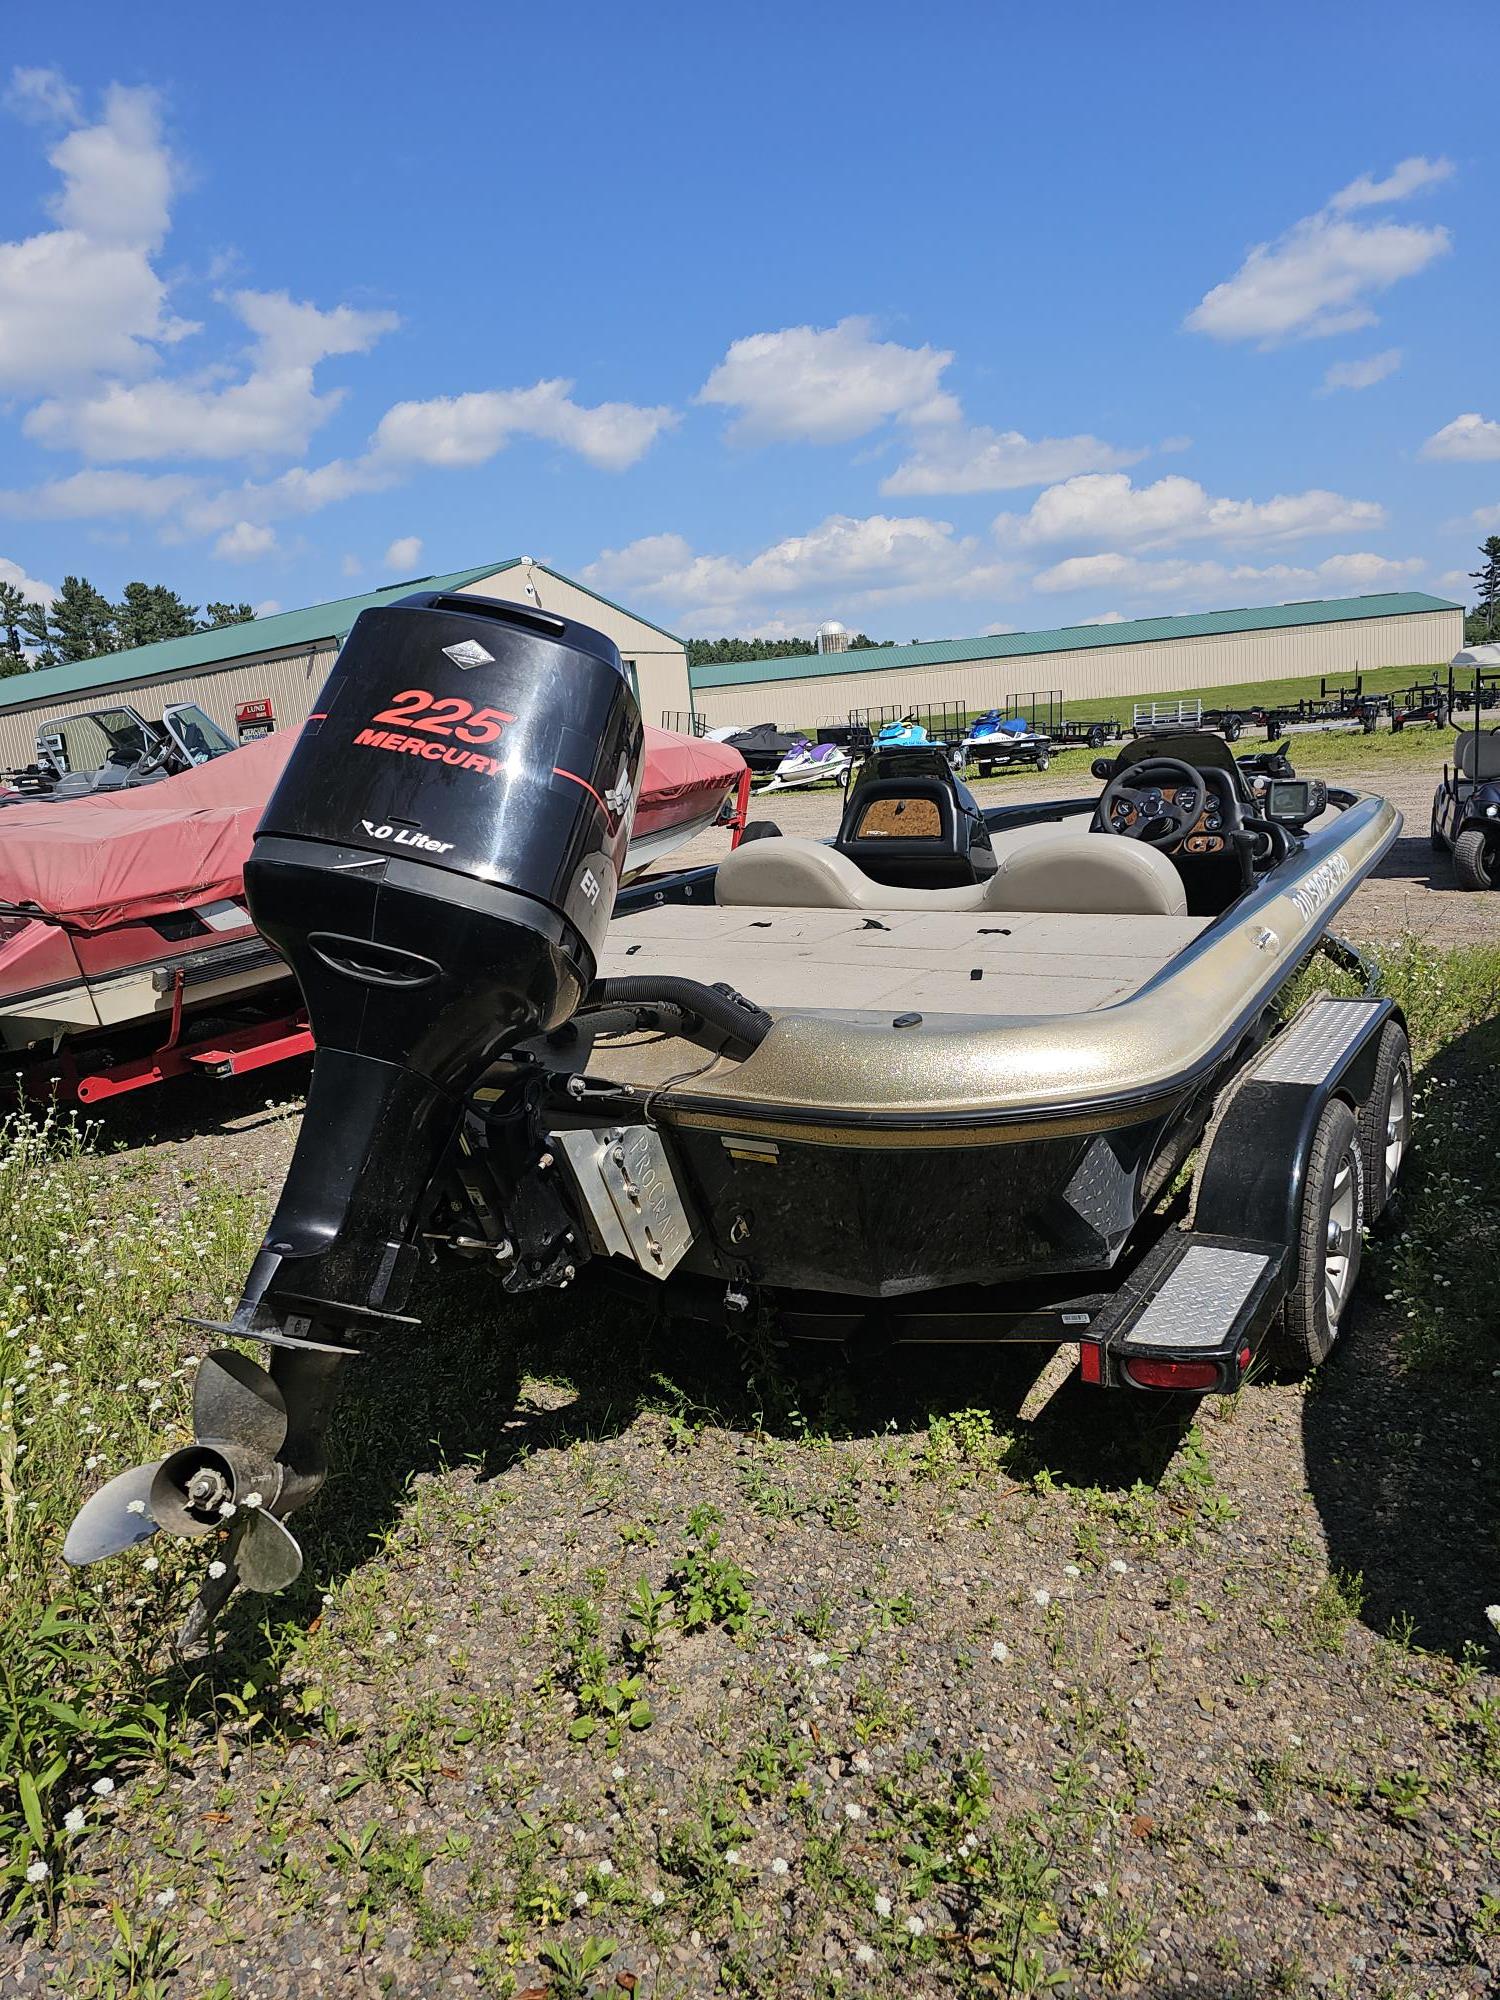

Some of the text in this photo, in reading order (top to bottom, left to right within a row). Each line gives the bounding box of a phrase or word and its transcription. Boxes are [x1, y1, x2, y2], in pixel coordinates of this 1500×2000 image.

[246, 704, 266, 714] LUND
[372, 689, 518, 744] 225
[242, 726, 268, 736] MERCURY
[352, 729, 507, 777] MERCURY
[393, 829, 456, 853] Liter
[579, 867, 601, 907] EFI
